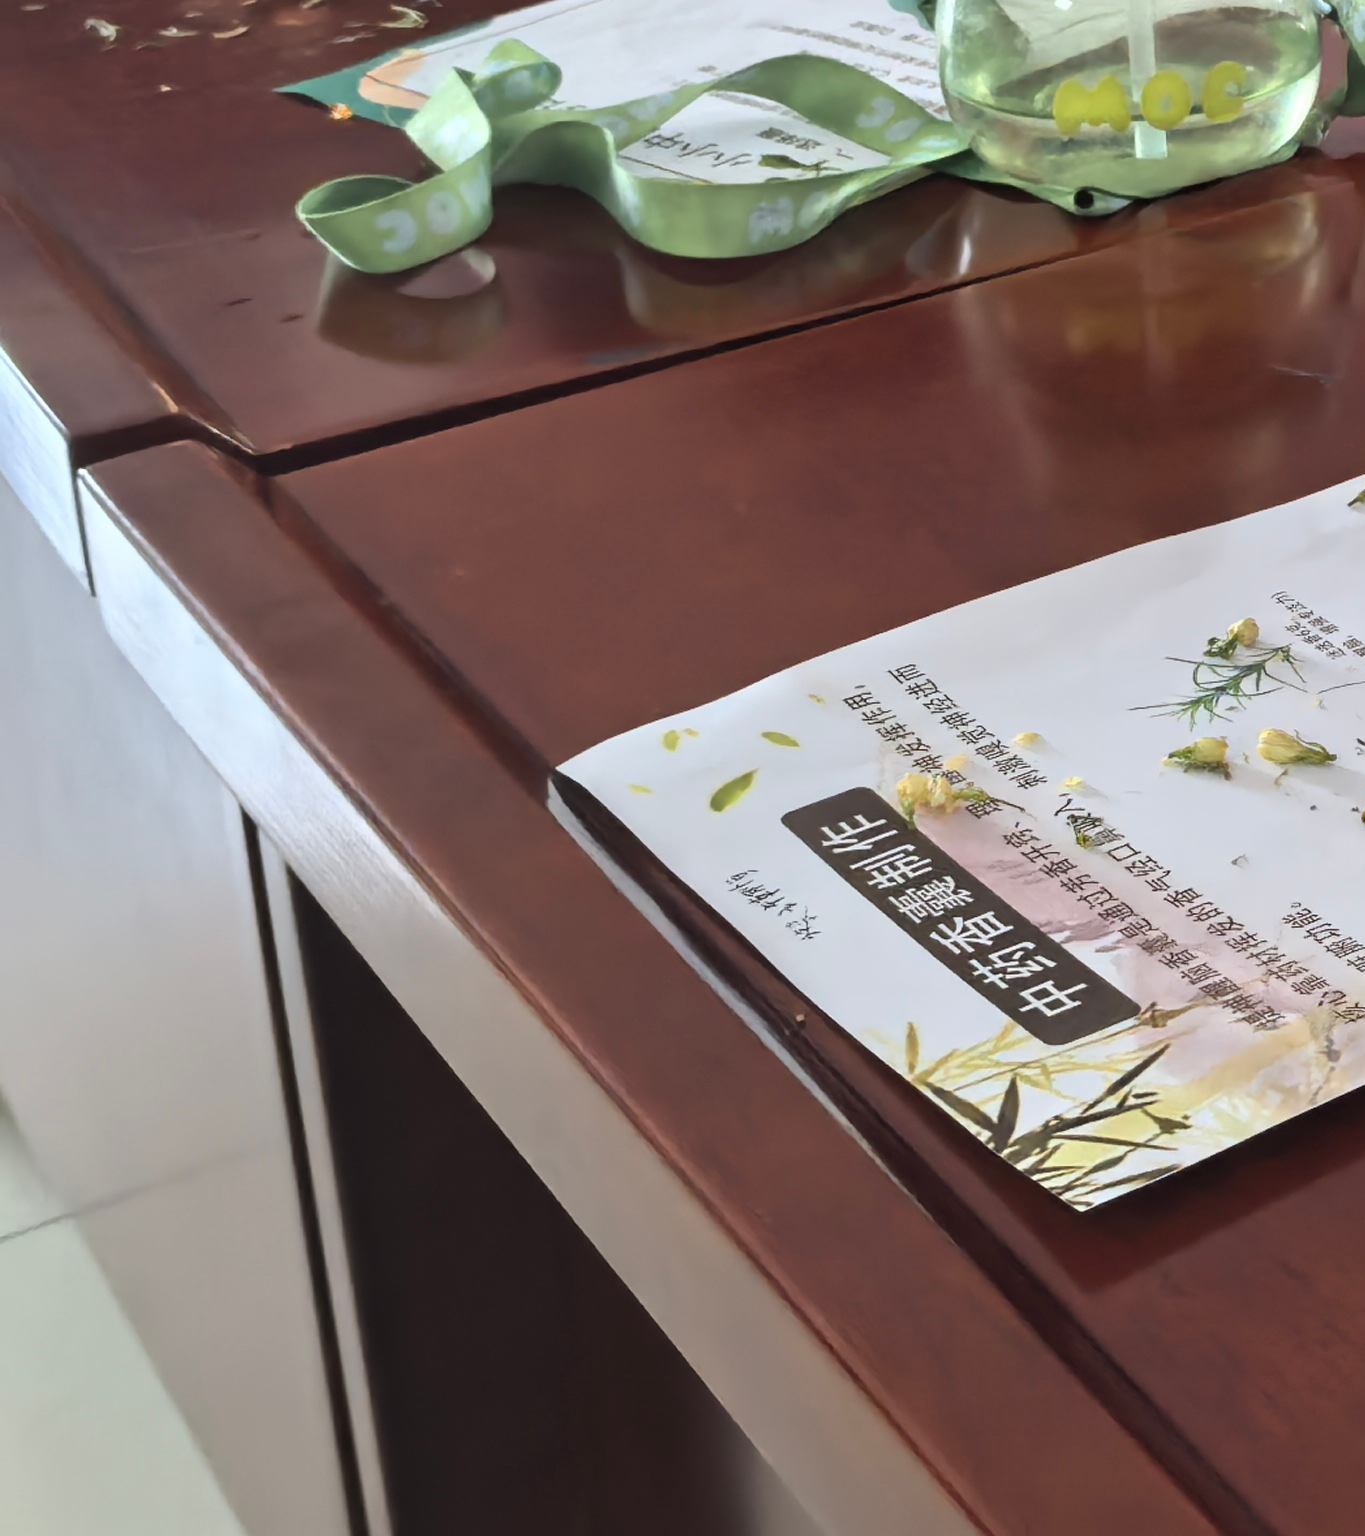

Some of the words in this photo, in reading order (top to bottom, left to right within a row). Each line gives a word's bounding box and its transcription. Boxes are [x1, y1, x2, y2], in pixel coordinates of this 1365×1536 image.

[811, 801, 1095, 1030] 中药香囊制作
